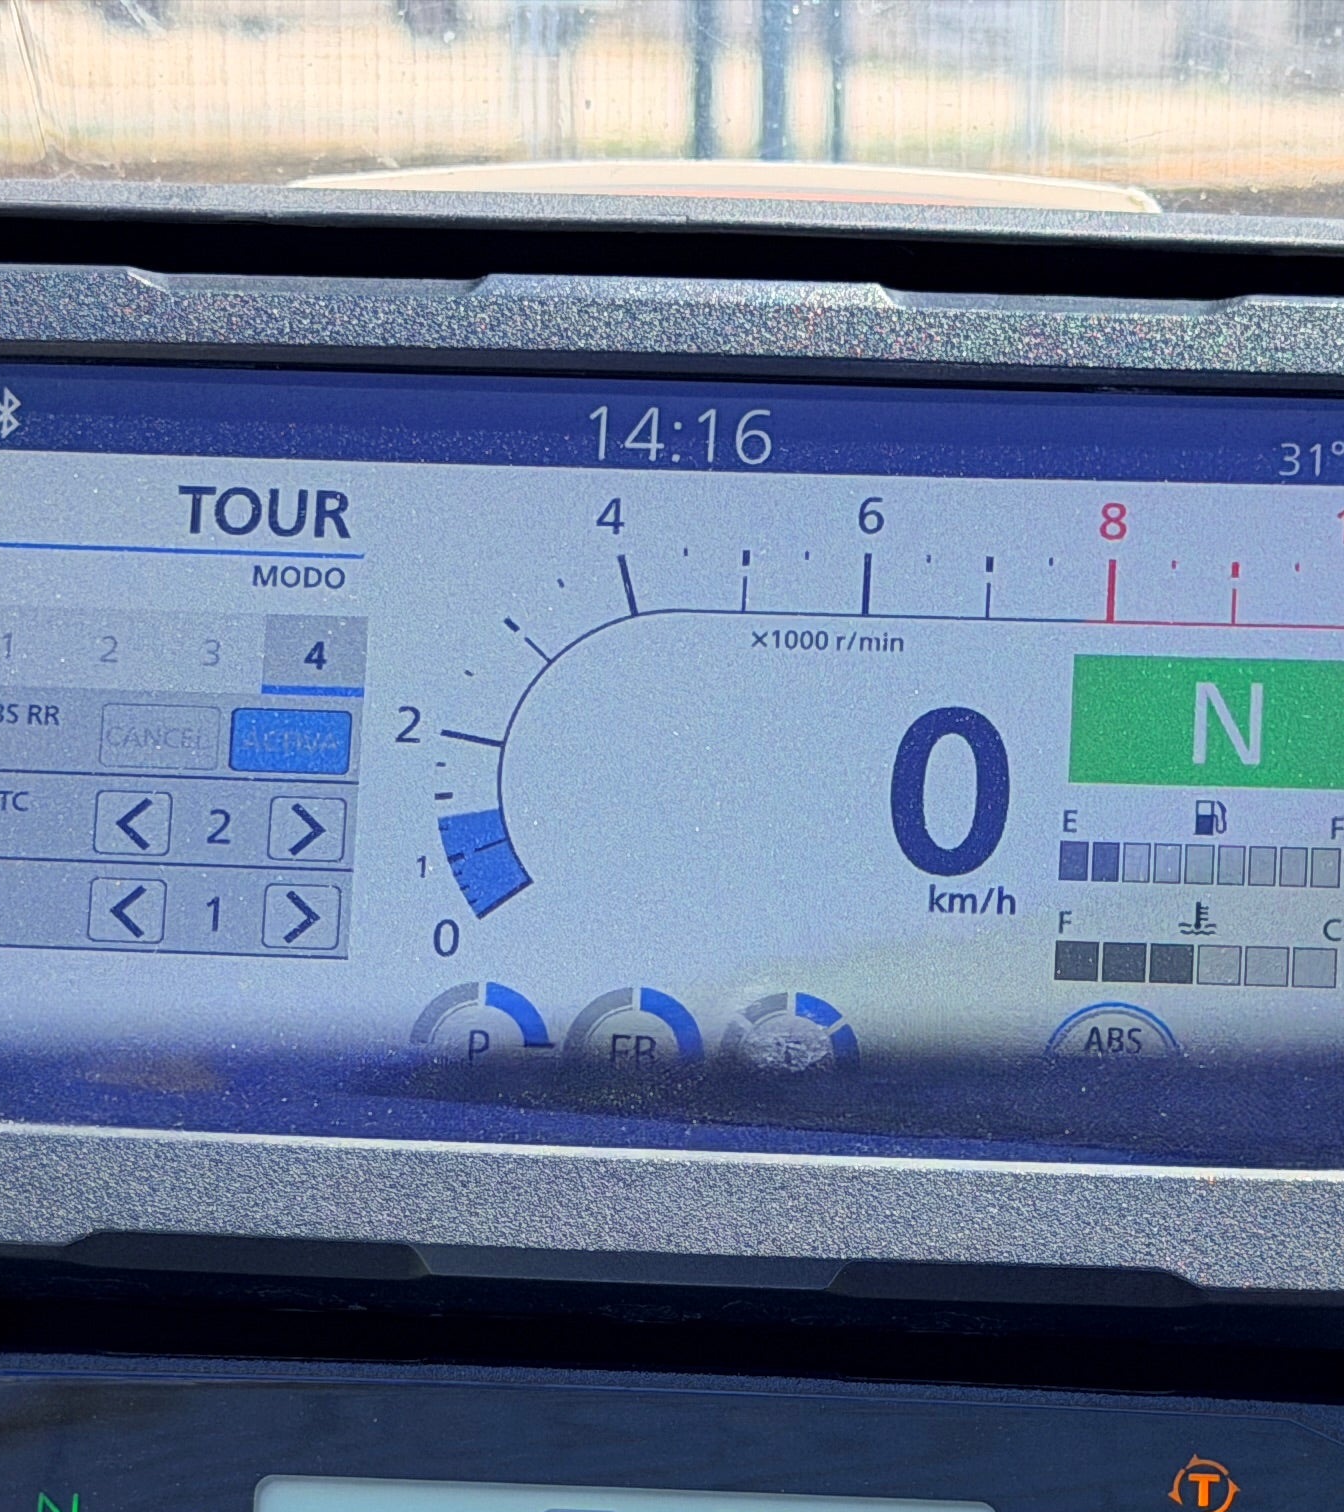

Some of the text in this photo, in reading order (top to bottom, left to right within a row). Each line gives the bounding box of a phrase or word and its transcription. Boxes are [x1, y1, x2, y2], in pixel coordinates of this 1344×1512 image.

[589, 405, 773, 466] 14:16
[178, 485, 351, 539] TOUR
[595, 497, 625, 535] 4
[857, 496, 885, 535] 6
[1098, 502, 1128, 541] 8
[251, 564, 347, 590] MODO
[1, 632, 328, 671] 1 2 3 4
[835, 630, 905, 653] r/min
[27, 704, 61, 727] RR
[394, 706, 421, 744] 2
[1192, 681, 1264, 765] N
[106, 726, 214, 750] CANCEL
[889, 706, 1010, 877] 0
[205, 808, 232, 845] 2
[1063, 810, 1078, 833] E
[417, 856, 429, 878] 1
[205, 895, 222, 933] 1
[927, 885, 1017, 916] km/h
[433, 918, 460, 957] 0
[1057, 911, 1073, 934] F
[1322, 919, 1342, 942] C
[468, 1029, 490, 1064] P
[1084, 1026, 1143, 1055] ABS
[1187, 1473, 1221, 1508] T
